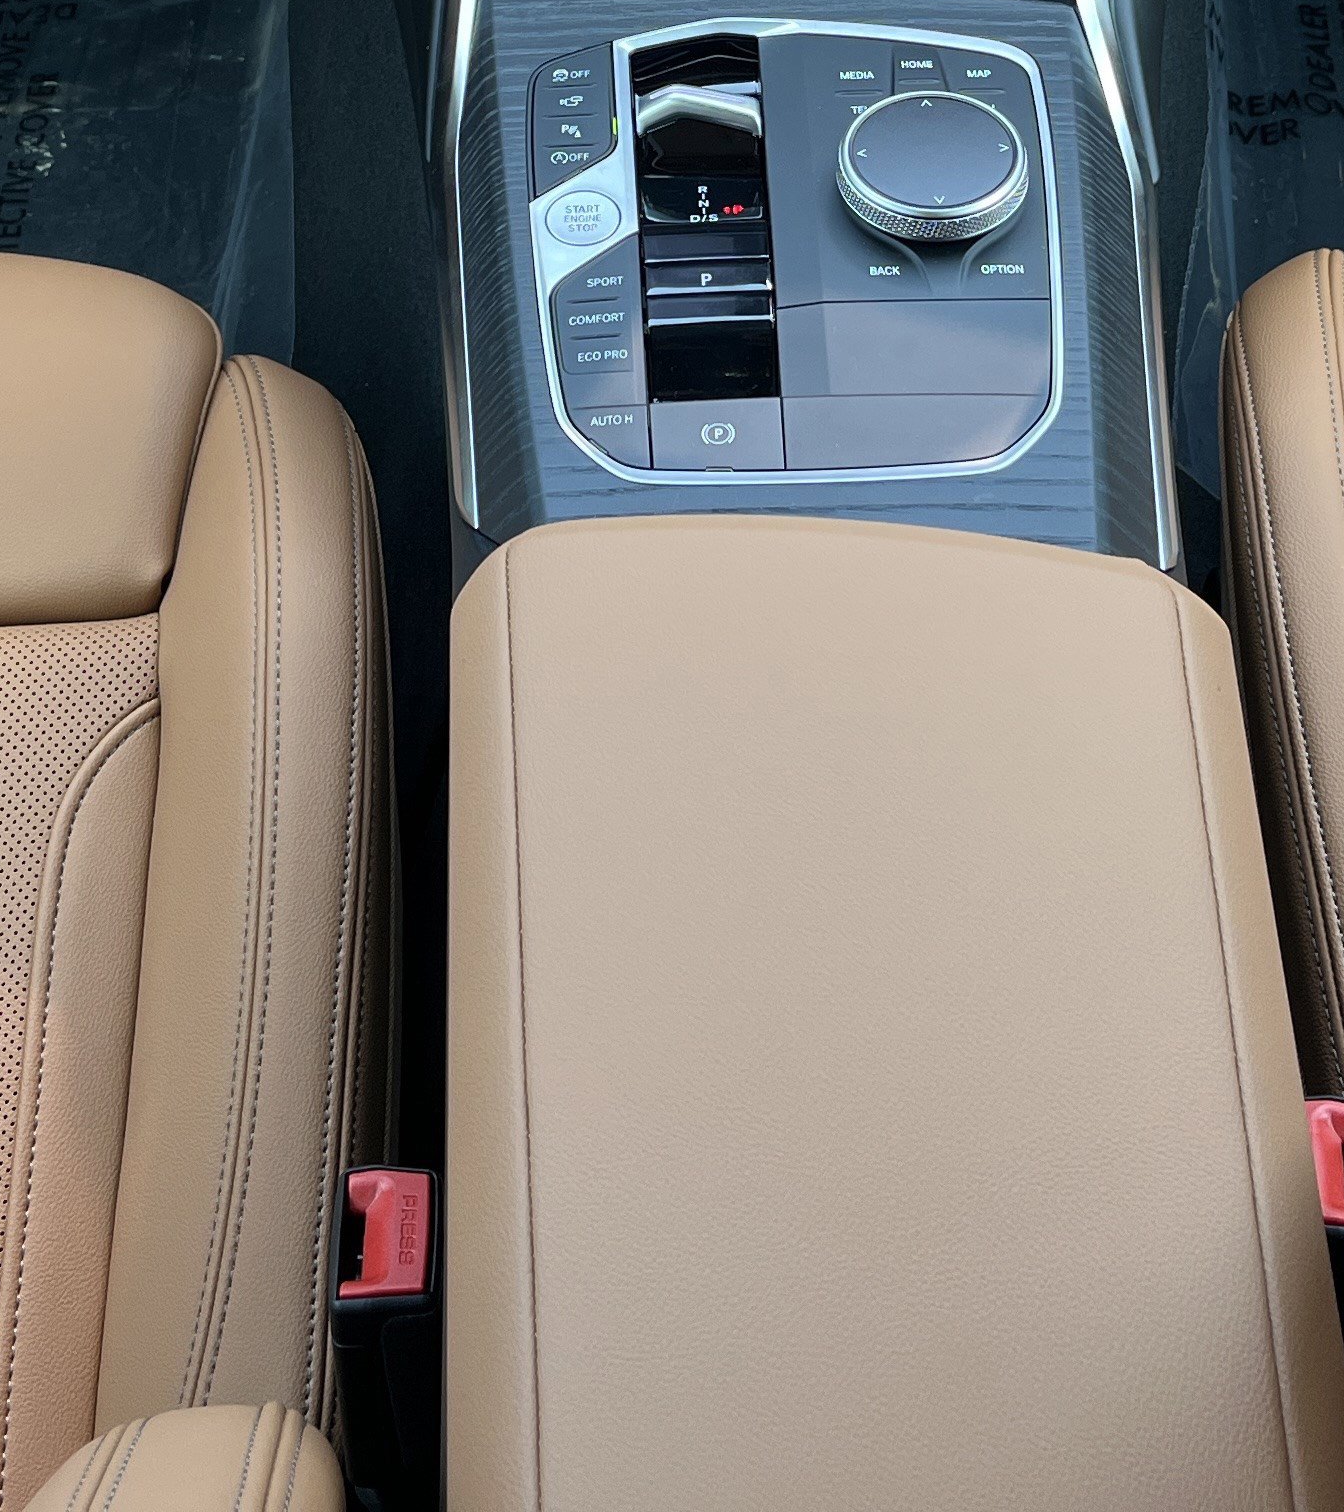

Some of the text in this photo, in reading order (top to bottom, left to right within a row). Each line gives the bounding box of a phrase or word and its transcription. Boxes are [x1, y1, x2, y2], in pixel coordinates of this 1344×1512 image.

[1296, 3, 1337, 93] DEALER
[900, 60, 933, 69] HOME
[570, 69, 591, 79] OFF
[839, 71, 875, 80] MEDIA
[966, 69, 991, 78] MAP
[568, 152, 590, 162] OFF
[697, 185, 708, 194] R
[564, 204, 601, 214] START
[698, 200, 709, 208] N
[563, 213, 602, 224] ENGINE
[568, 223, 599, 233] STOP
[869, 266, 901, 276] BACK
[980, 264, 1025, 275] OPTION
[586, 275, 624, 288] SPORT
[700, 273, 713, 287] P
[568, 312, 625, 326] COMFORT
[577, 349, 628, 363] ECO PRO
[590, 414, 634, 427] AUTO H
[398, 1193, 418, 1266] PRESS
